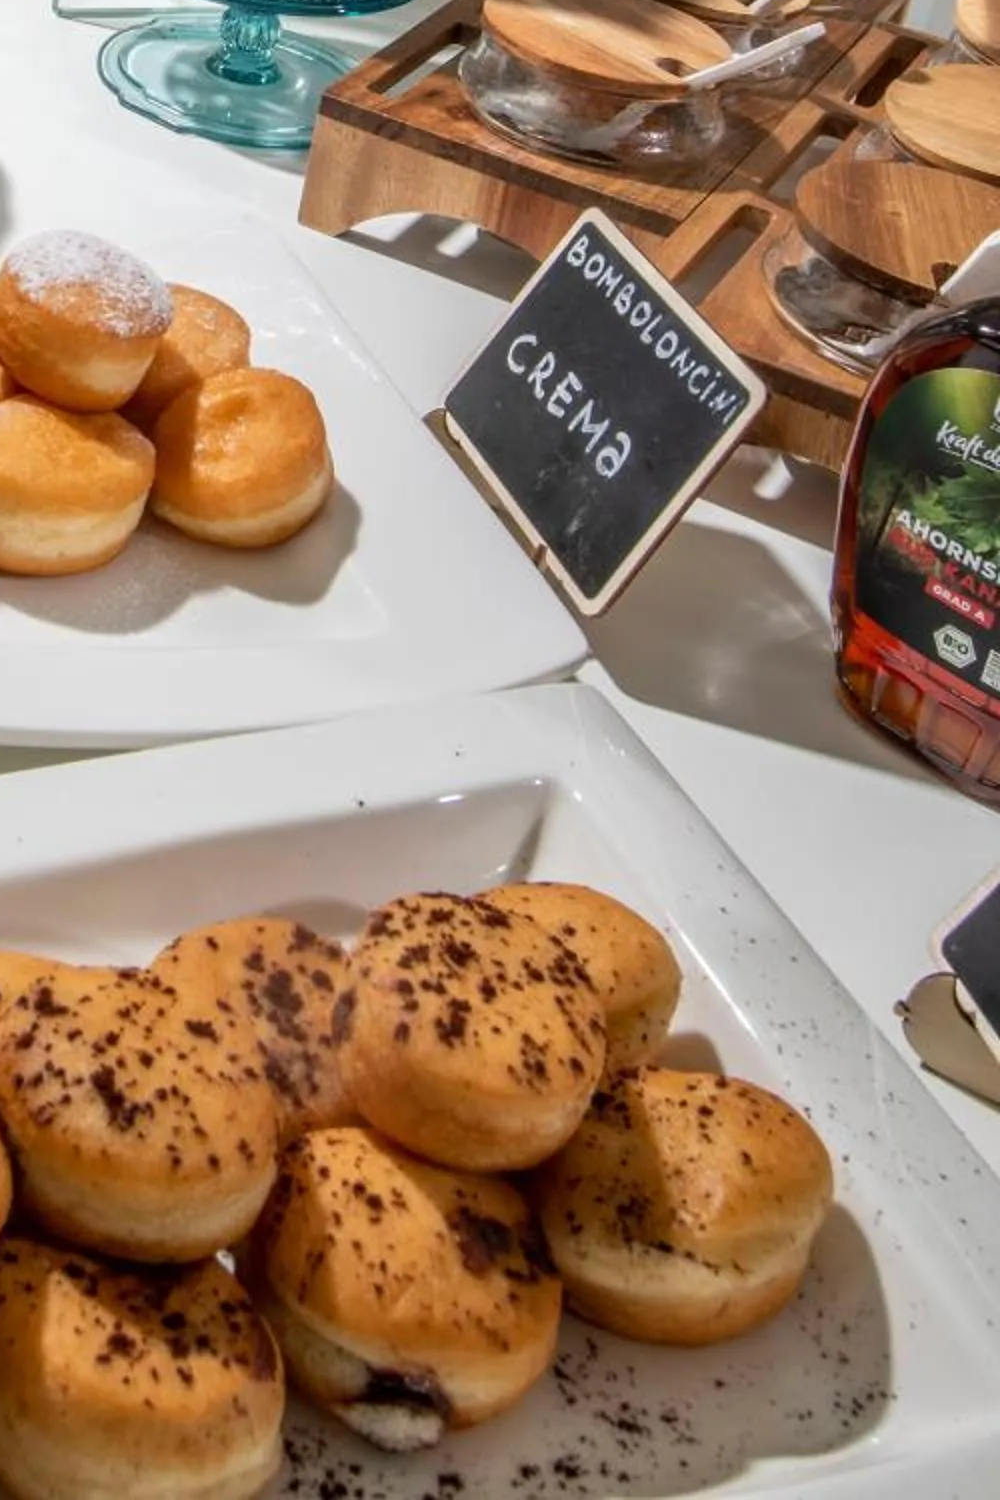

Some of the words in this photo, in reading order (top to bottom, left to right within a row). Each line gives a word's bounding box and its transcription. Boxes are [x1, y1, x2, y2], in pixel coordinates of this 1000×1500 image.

[936, 420, 985, 460] Kraft
[932, 585, 970, 612] GRAD
[973, 610, 985, 622] A
